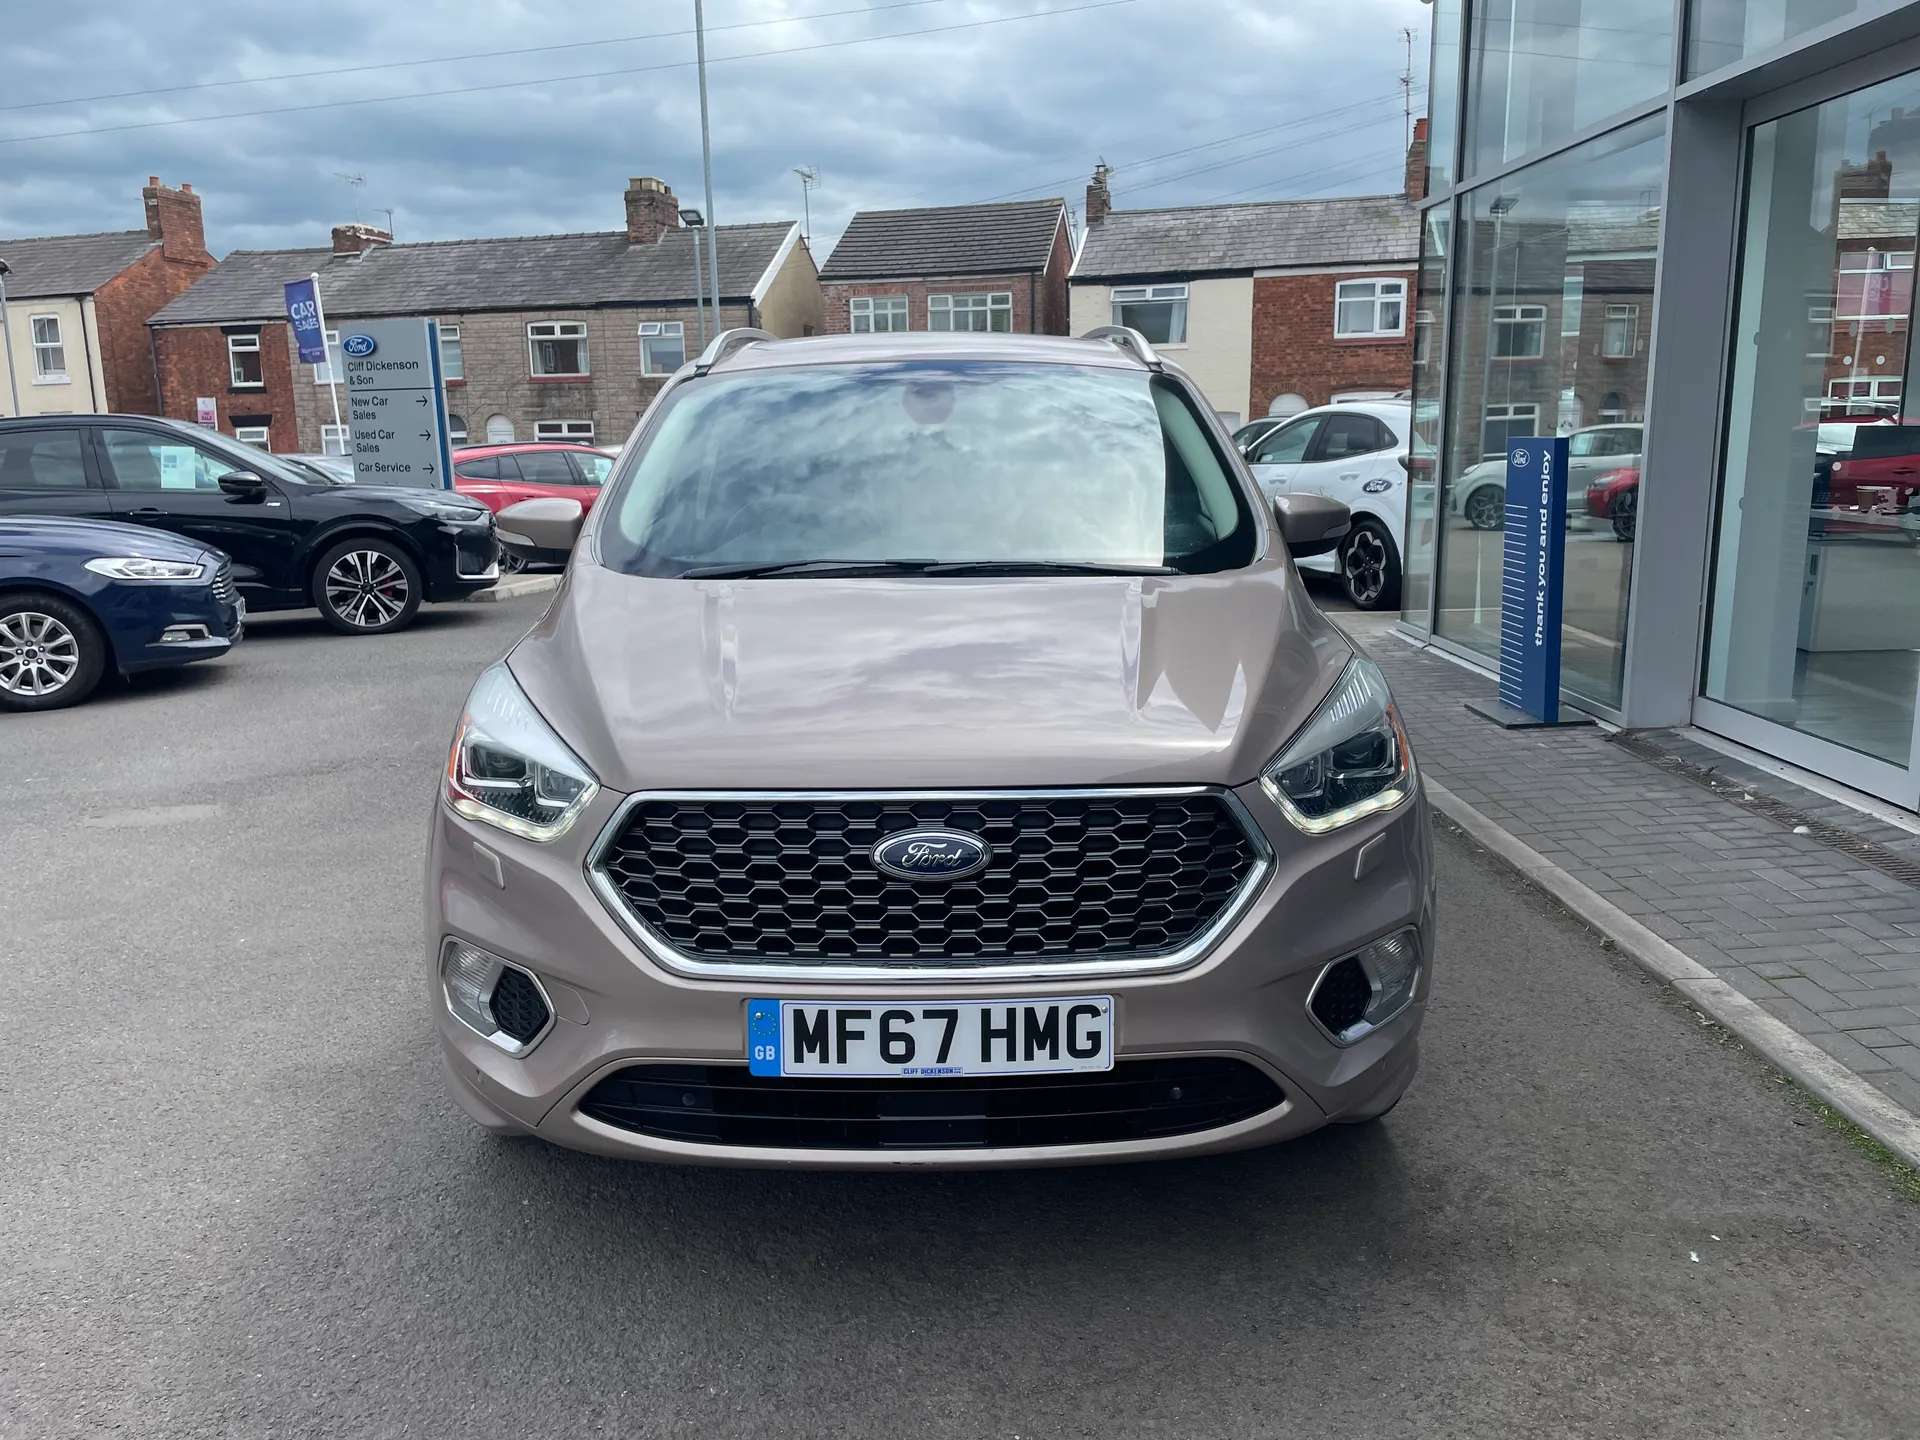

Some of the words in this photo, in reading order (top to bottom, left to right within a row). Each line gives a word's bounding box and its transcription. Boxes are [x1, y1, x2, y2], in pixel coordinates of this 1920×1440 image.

[291, 301, 316, 319] CAR
[295, 318, 319, 331] SALES
[348, 338, 368, 352] Ford
[347, 360, 364, 372] Cliff
[366, 360, 419, 371] Dickenson
[349, 375, 355, 385] &
[356, 375, 374, 385] Son
[351, 397, 370, 407] New
[371, 396, 388, 406] Car
[353, 410, 377, 420] Sales
[355, 429, 377, 440] Used
[378, 429, 395, 439] Car
[356, 443, 380, 453] Sales
[358, 462, 373, 472] Car
[375, 462, 411, 472] Service
[1541, 450, 1551, 505] enjoy
[1539, 508, 1548, 548] and
[1537, 550, 1546, 587] you
[1535, 589, 1545, 647] thank
[901, 842, 962, 867] Ford
[792, 1009, 959, 1064] MF67
[980, 1004, 1102, 1063] HMG
[754, 1046, 776, 1060] GB
